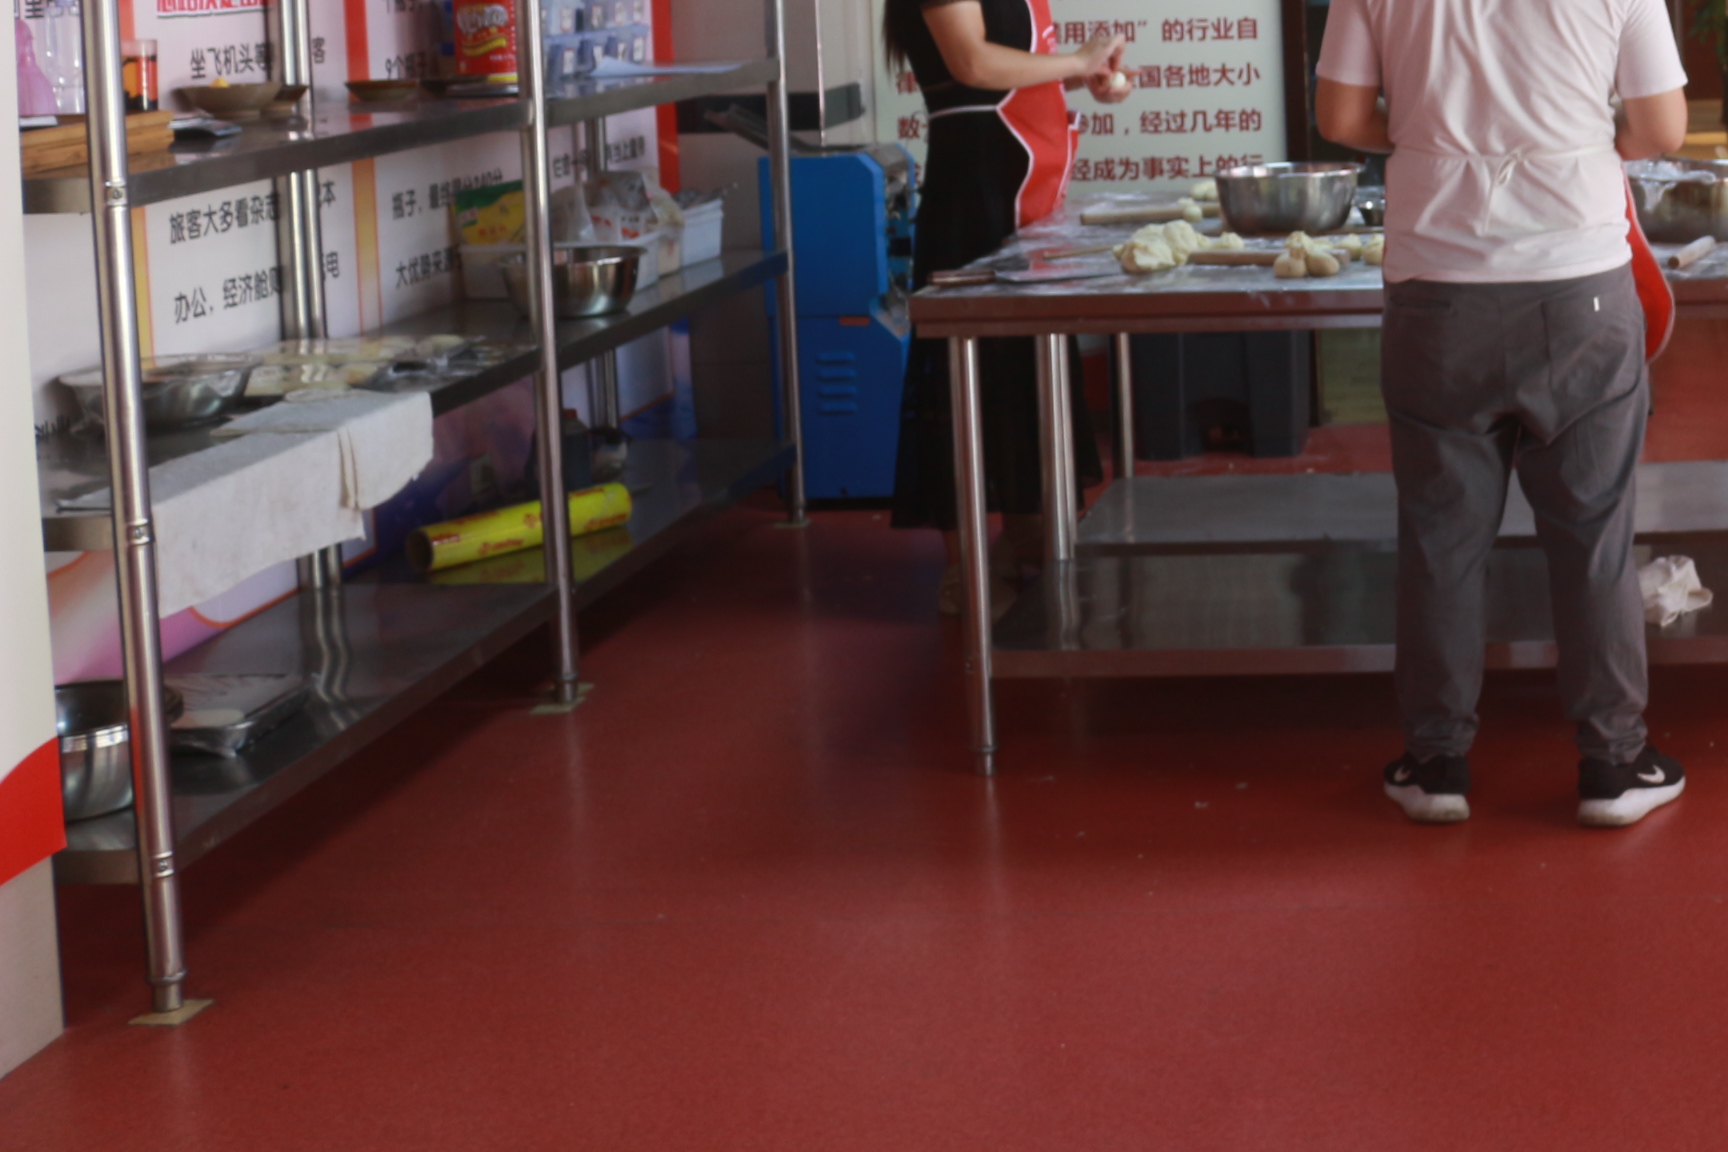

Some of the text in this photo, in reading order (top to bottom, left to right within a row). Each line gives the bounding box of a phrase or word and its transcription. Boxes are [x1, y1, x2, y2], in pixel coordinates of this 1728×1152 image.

[1133, 64, 1260, 89] 国各地大小
